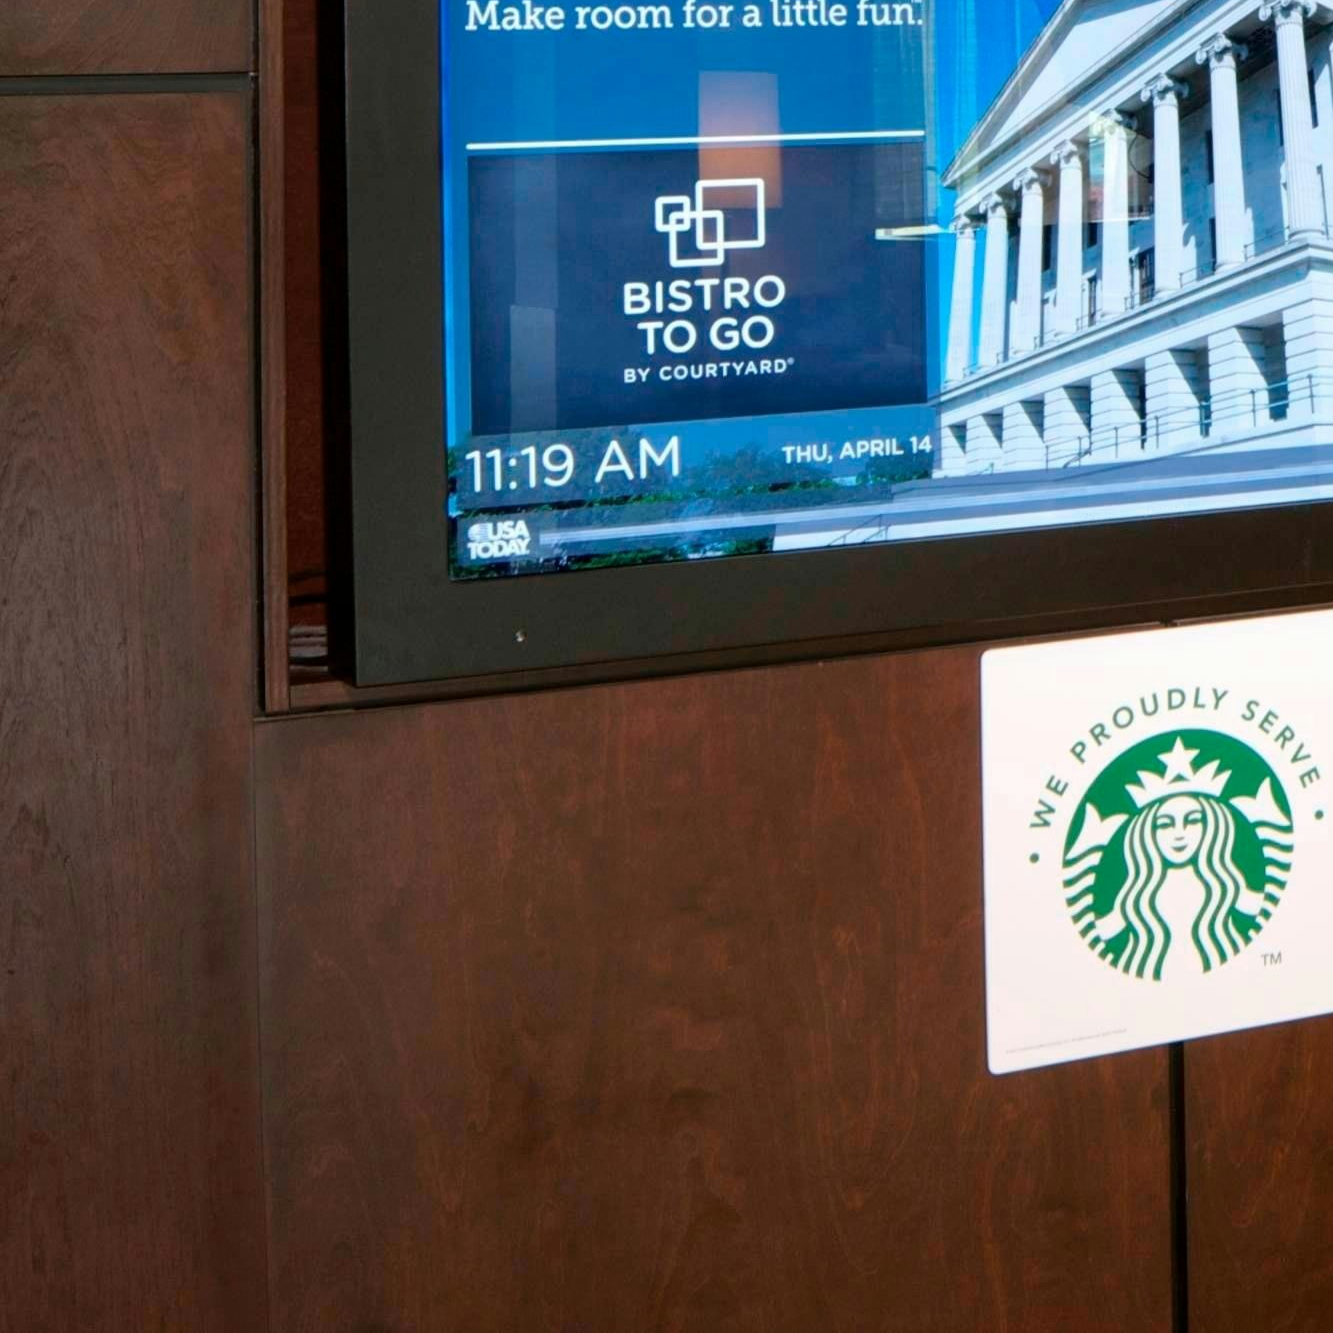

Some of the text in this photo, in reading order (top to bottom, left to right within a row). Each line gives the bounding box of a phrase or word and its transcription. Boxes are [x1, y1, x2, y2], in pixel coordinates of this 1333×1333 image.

[465, 0, 566, 31] Make
[575, 5, 673, 29] room
[742, 5, 762, 28] a
[623, 275, 786, 316] BISTRO
[637, 315, 775, 355] TO GO
[624, 367, 650, 383] BY
[465, 435, 681, 493] 11:19 AM
[782, 435, 933, 466] THU, APRIL 14
[488, 520, 530, 540] USA
[1029, 687, 1321, 830] WE PROUDLY SERVE
